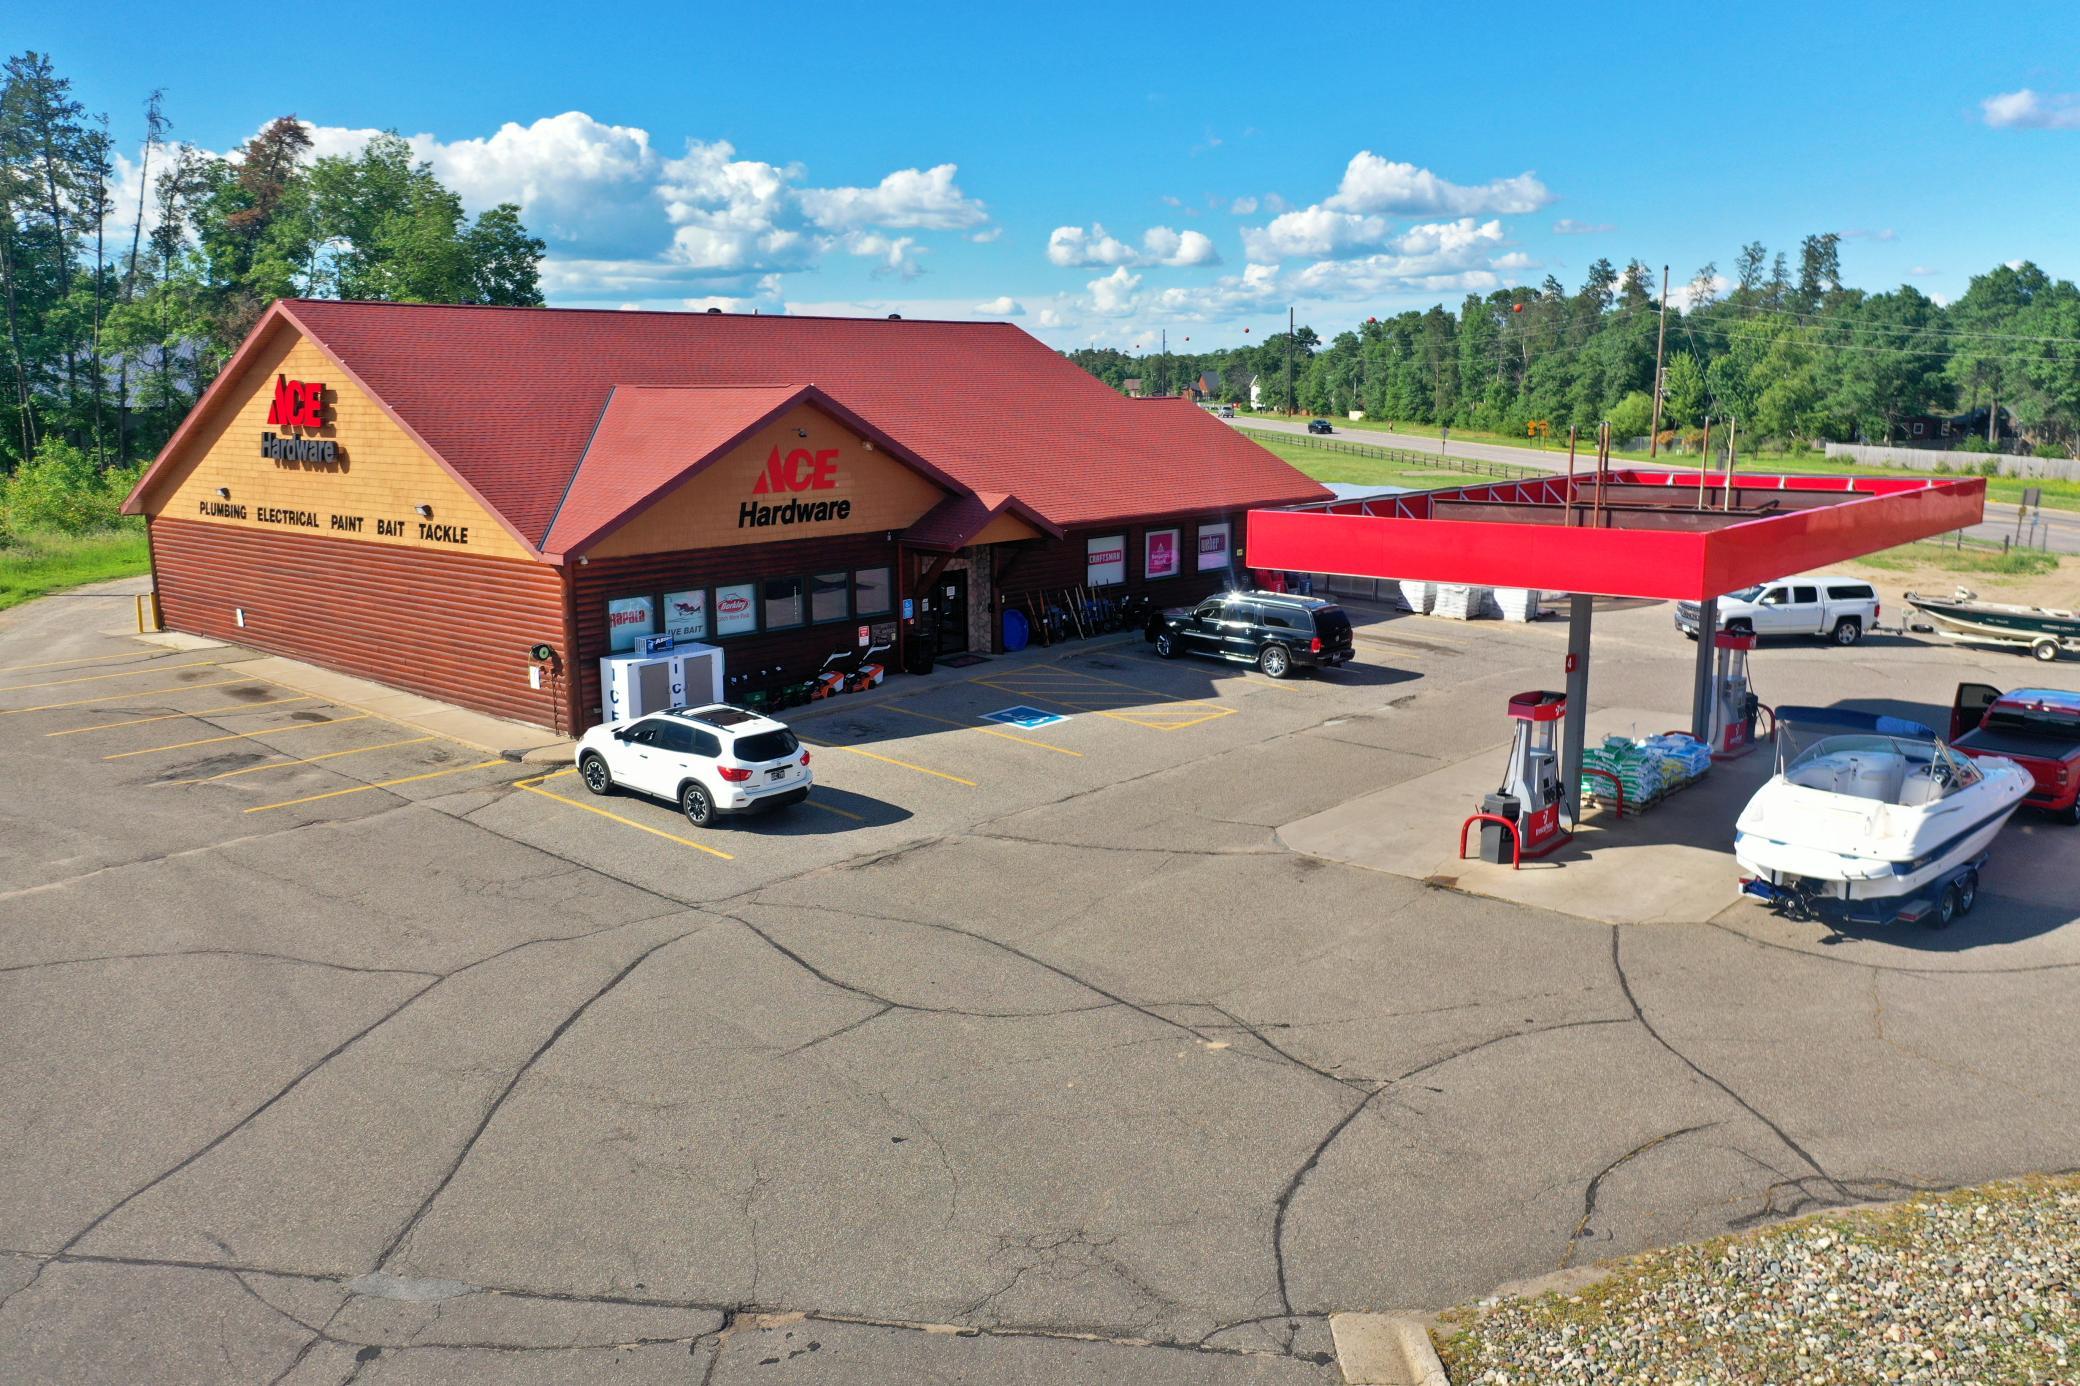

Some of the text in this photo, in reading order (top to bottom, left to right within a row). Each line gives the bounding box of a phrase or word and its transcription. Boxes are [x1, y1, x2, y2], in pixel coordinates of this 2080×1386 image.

[267, 373, 325, 428] ACE
[261, 432, 338, 464] Hardware
[752, 444, 840, 494] ACE
[199, 501, 469, 544] PLUMBING ELECTRICAL PAINT BAIT TACKLE
[738, 498, 851, 529] Hardware
[683, 625, 704, 635] BAIT
[1567, 656, 1572, 669] 4
